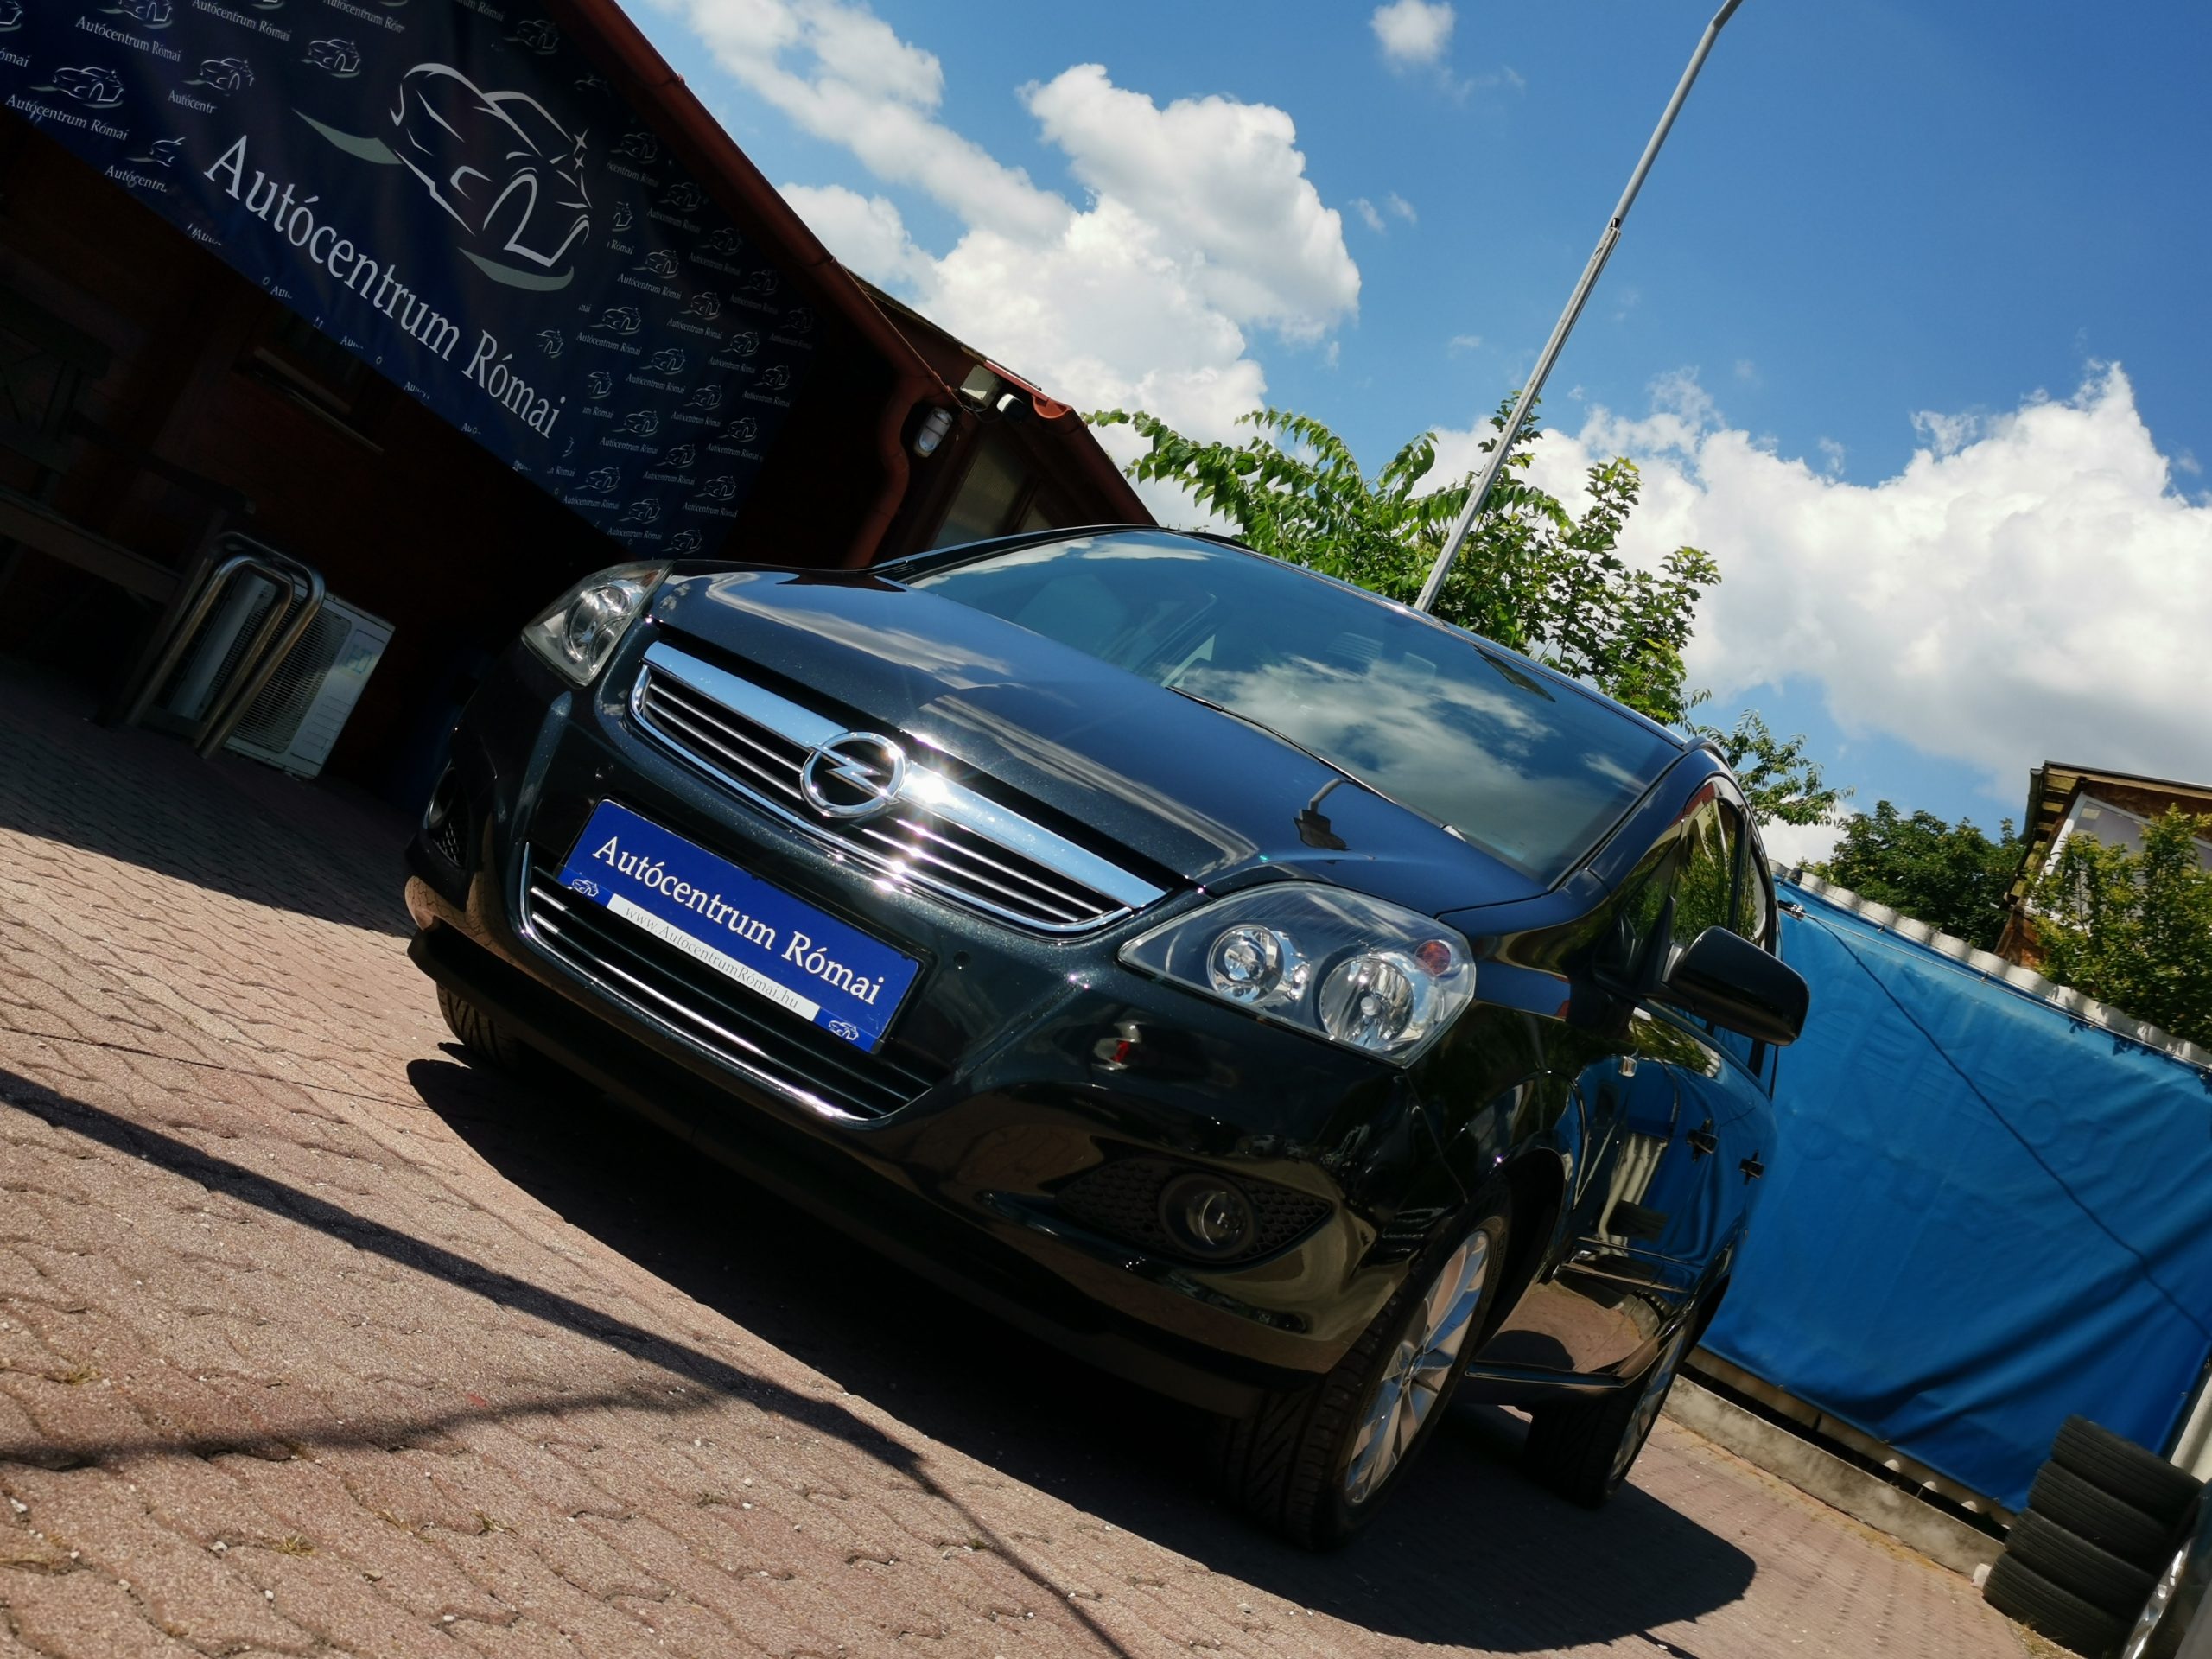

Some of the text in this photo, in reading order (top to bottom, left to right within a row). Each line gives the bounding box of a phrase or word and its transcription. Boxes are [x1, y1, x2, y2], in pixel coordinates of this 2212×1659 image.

[192, 0, 291, 41] Autócentrum Római
[477, 3, 505, 22] Római
[74, 16, 181, 63] Autócentrum Római
[5, 93, 130, 142] Autócentrum Római
[612, 238, 636, 256] Római
[203, 134, 567, 439] Autócentrum Római
[617, 273, 683, 301] Autócentrum Római
[576, 331, 643, 356] Autócentrum Római
[591, 836, 886, 1006] Autócentrum Római
[625, 907, 799, 1009] www.AutócentrumRómai.hu
